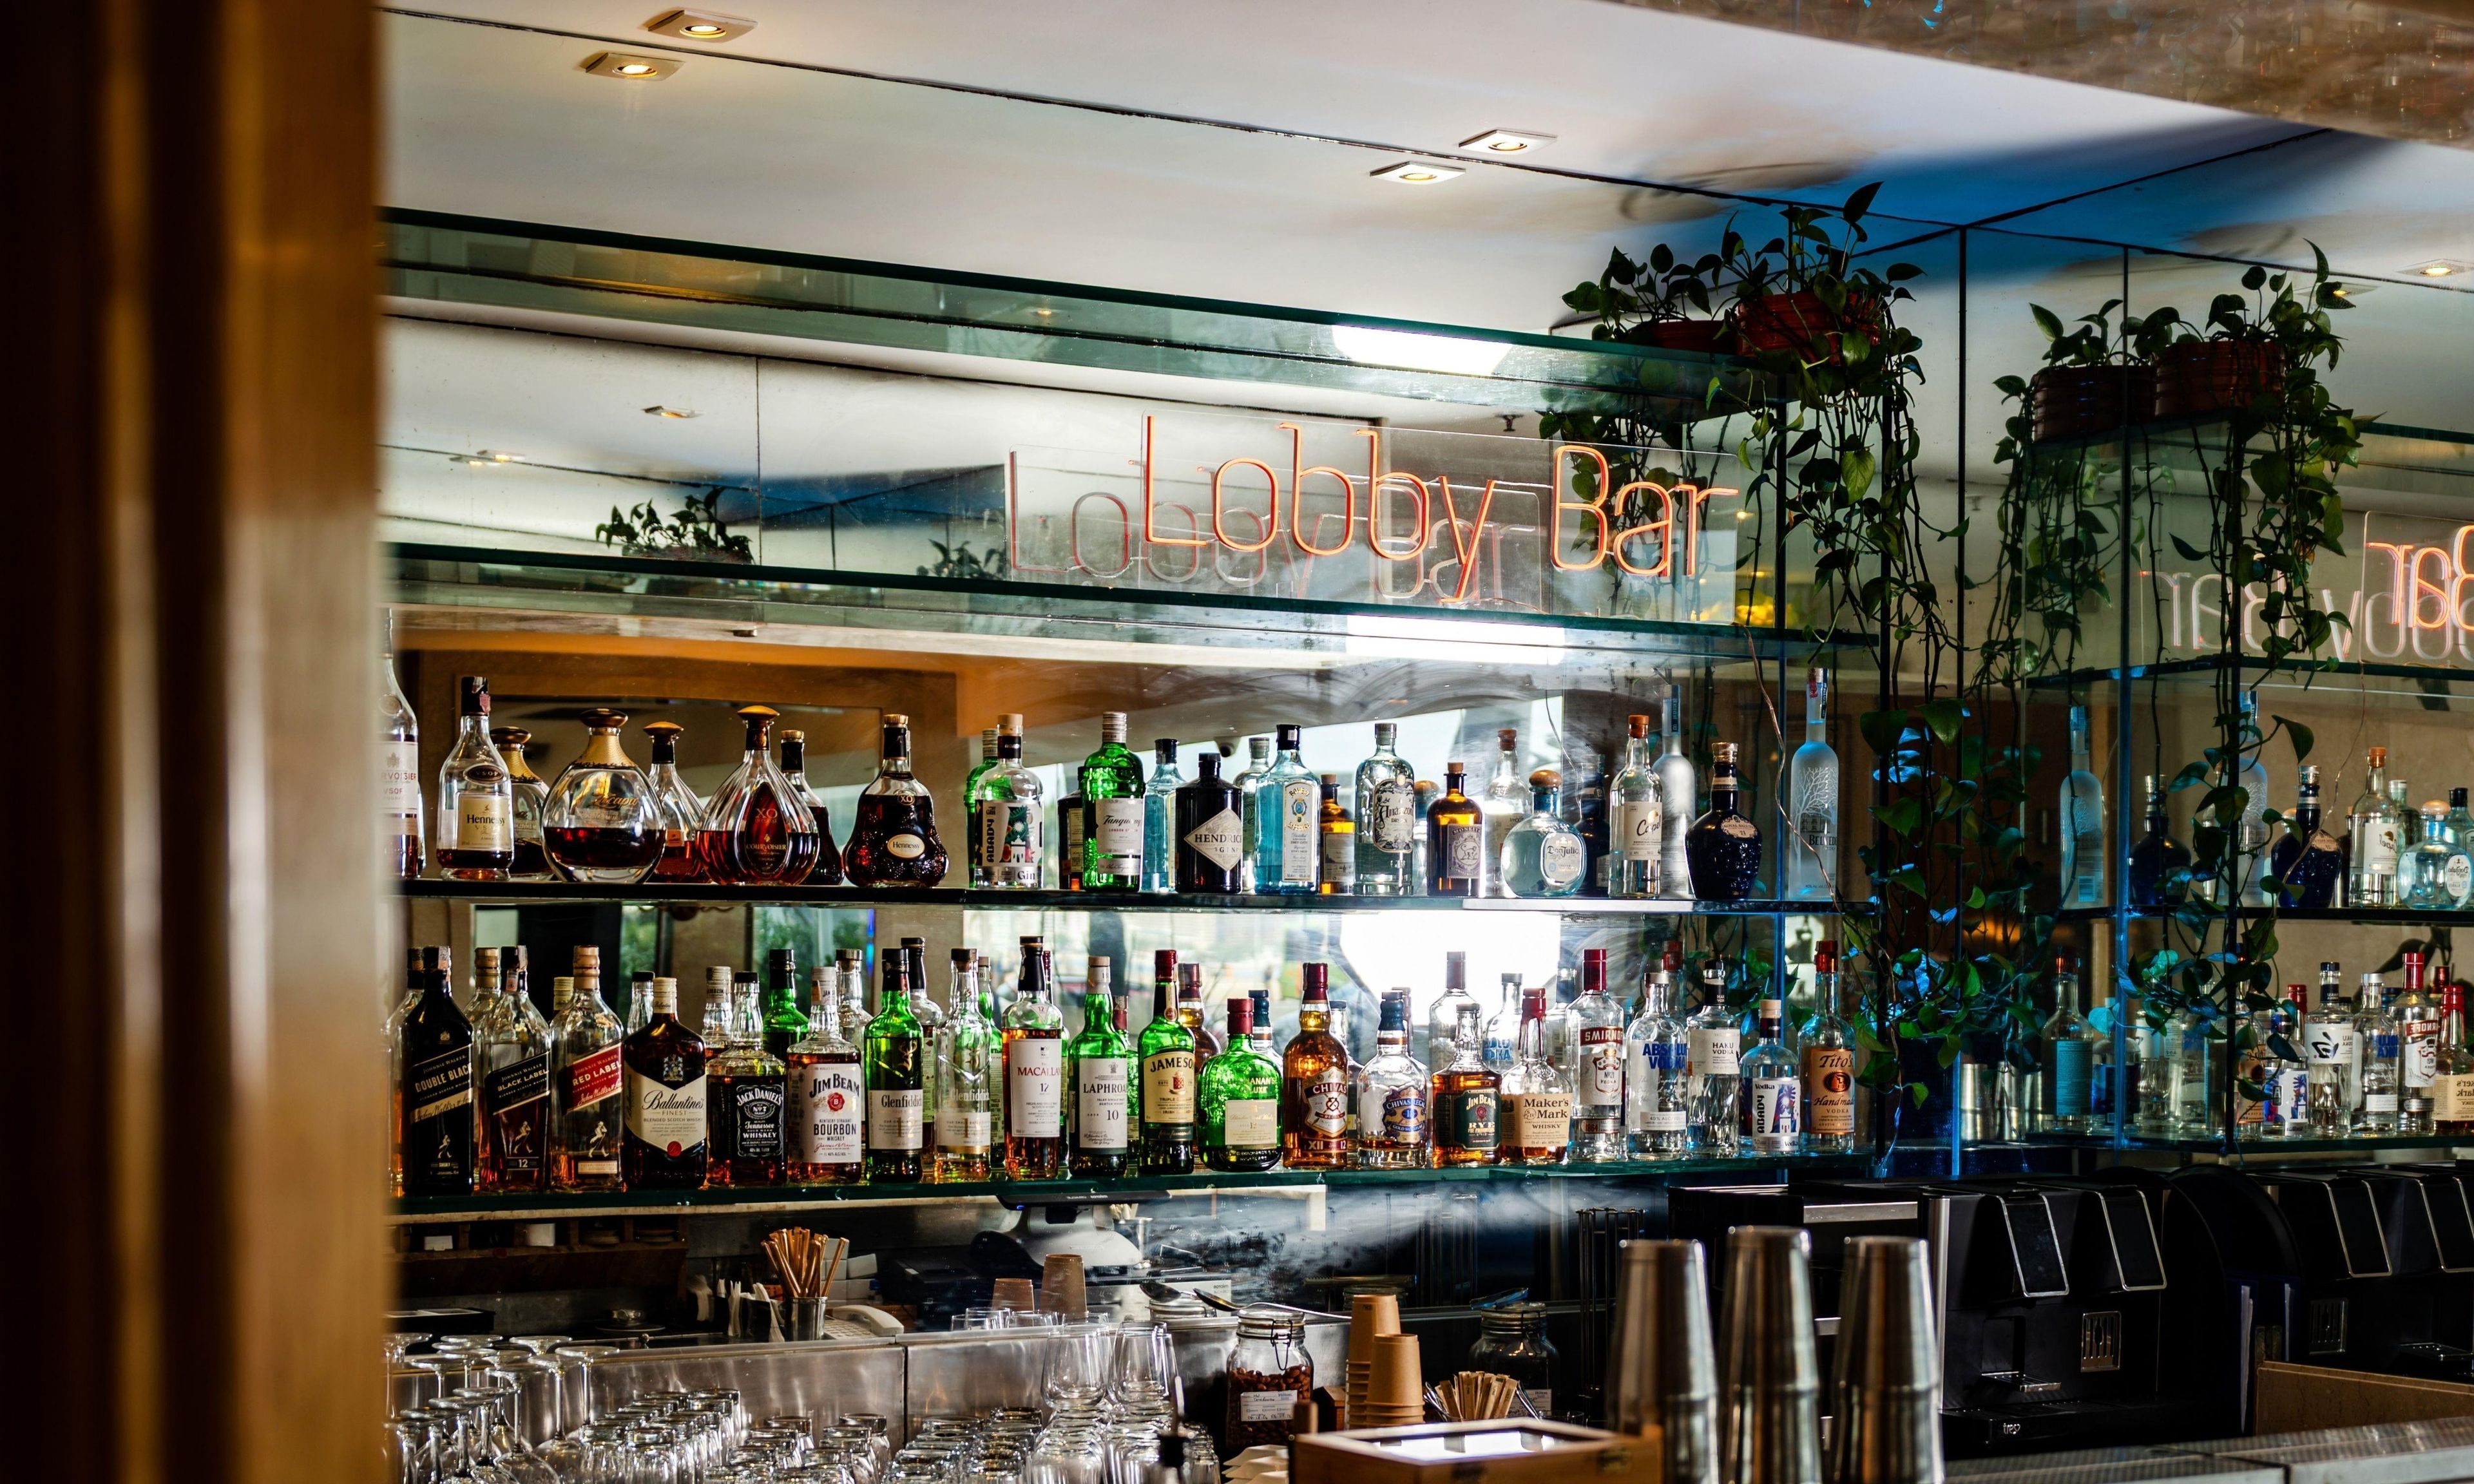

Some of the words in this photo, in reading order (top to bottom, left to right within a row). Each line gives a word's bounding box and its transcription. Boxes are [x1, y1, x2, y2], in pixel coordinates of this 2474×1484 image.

[1145, 414, 1496, 602] Lobby
[1553, 444, 1740, 577] Bar
[755, 808, 778, 819] XO
[1018, 870, 1035, 880] Gin
[1150, 1057, 1193, 1073] JAMESO
[1819, 1054, 1854, 1068] Tito's
[415, 1073, 447, 1093] DOUBLE
[448, 1063, 473, 1081] BLACK
[572, 1073, 591, 1087] RED
[593, 1060, 622, 1078] LABEL
[497, 1078, 523, 1092] BLACK
[524, 1068, 550, 1082] LABEL
[809, 1078, 831, 1098] JIM
[832, 1073, 859, 1097] BEAM
[1040, 1083, 1049, 1092] 12
[1083, 1083, 1126, 1094] LAPHROA
[1312, 1083, 1347, 1094] CHIVAS
[642, 1089, 705, 1110] Ballantine's
[736, 1090, 755, 1106] JACK
[754, 1087, 783, 1106] DANIEL'S
[1466, 1097, 1479, 1110] JIM
[1479, 1094, 1496, 1109] BEAM
[1386, 1099, 1411, 1109] CHIVAS
[1524, 1098, 1569, 1108] Maker's
[1107, 1109, 1119, 1121] 10
[1537, 1109, 1568, 1119] Mark
[1757, 1094, 1765, 1134] ABADY
[745, 1121, 775, 1129] Tennessee
[814, 1123, 856, 1136] BOURBON
[1308, 1140, 1323, 1150] XII
[1340, 1140, 1347, 1149] 12
[518, 1159, 528, 1168] 12
